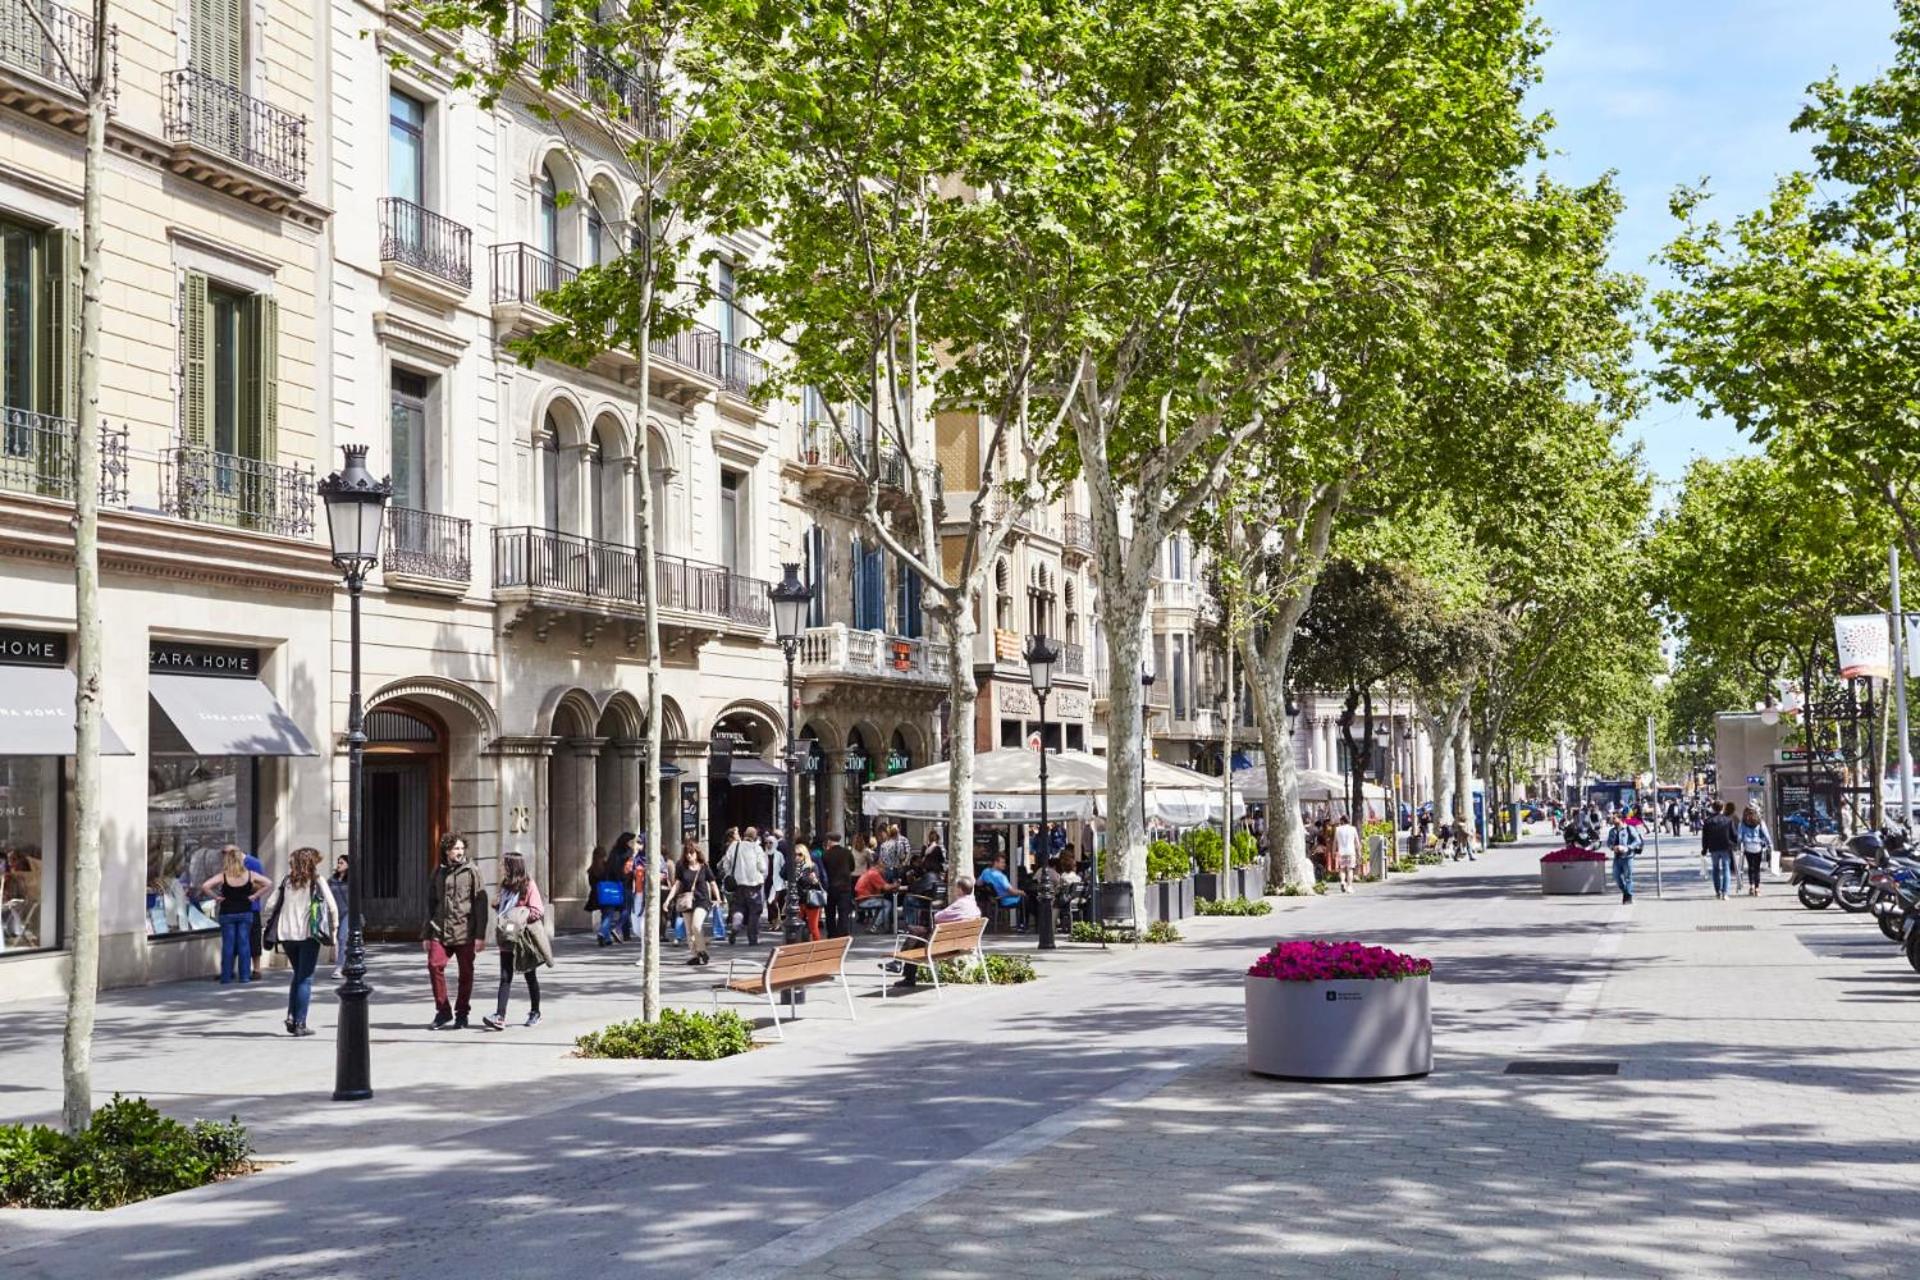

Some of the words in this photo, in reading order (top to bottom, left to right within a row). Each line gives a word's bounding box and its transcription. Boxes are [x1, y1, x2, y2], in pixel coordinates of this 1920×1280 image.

[0, 640, 55, 657] HOME
[149, 651, 194, 666] ZARA
[203, 655, 249, 670] HOME
[973, 800, 1007, 810] INUS.
